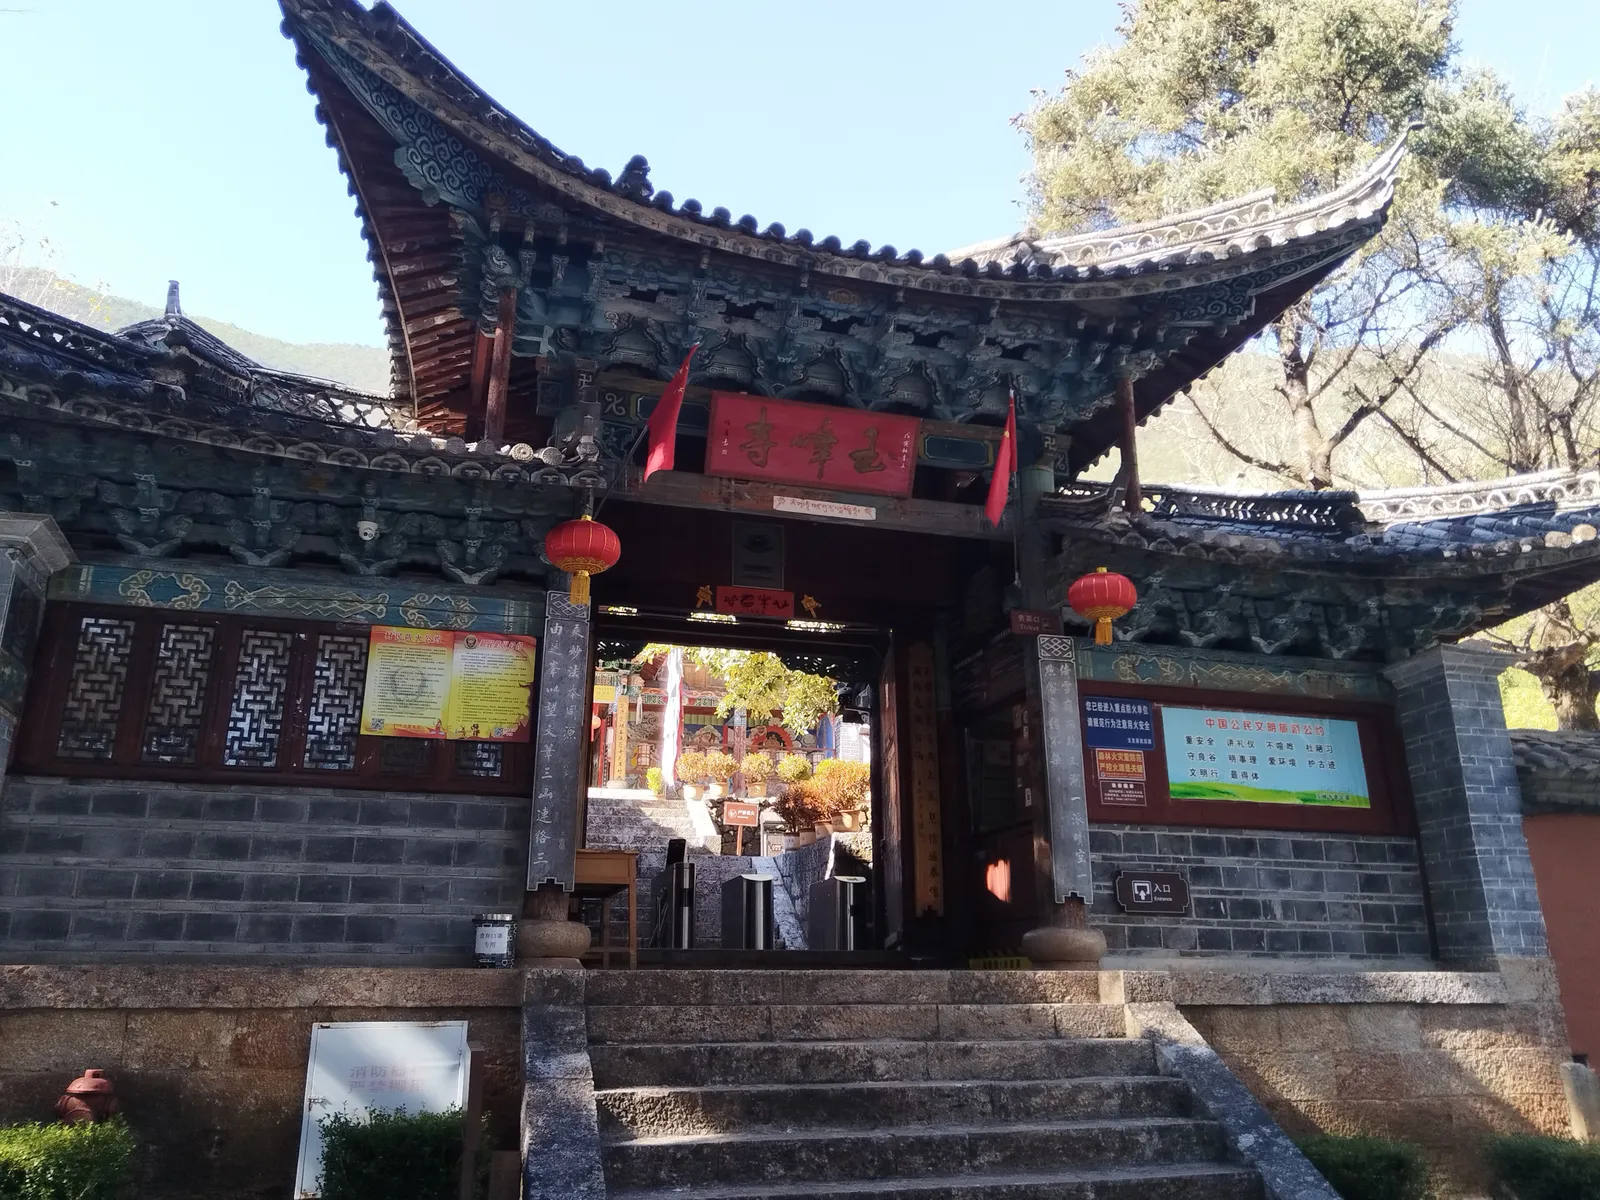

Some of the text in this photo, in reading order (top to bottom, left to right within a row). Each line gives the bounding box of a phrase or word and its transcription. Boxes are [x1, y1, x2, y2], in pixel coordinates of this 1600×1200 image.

[739, 405, 898, 479] 玉峰寺
[1085, 701, 1149, 715] 您已经进入重点防火单位
[1087, 717, 1150, 731] 请规范行为注意用火安全
[1205, 718, 1325, 736] 中国公民文明旅游公约
[1185, 735, 1215, 746] 重安全
[1226, 738, 1256, 749] 讲礼仪
[1266, 741, 1295, 751] 不喧哗
[1098, 751, 1143, 762] 森林火灾重防范
[1228, 754, 1258, 765] 明事理
[1268, 756, 1298, 767] 爱环境
[1307, 759, 1337, 770] 护古迹
[1099, 762, 1144, 773] 严控火源是关键
[1189, 768, 1260, 781] 文明行 最得体
[1153, 883, 1171, 893] 入口
[348, 1080, 424, 1094] 严禁挪用
